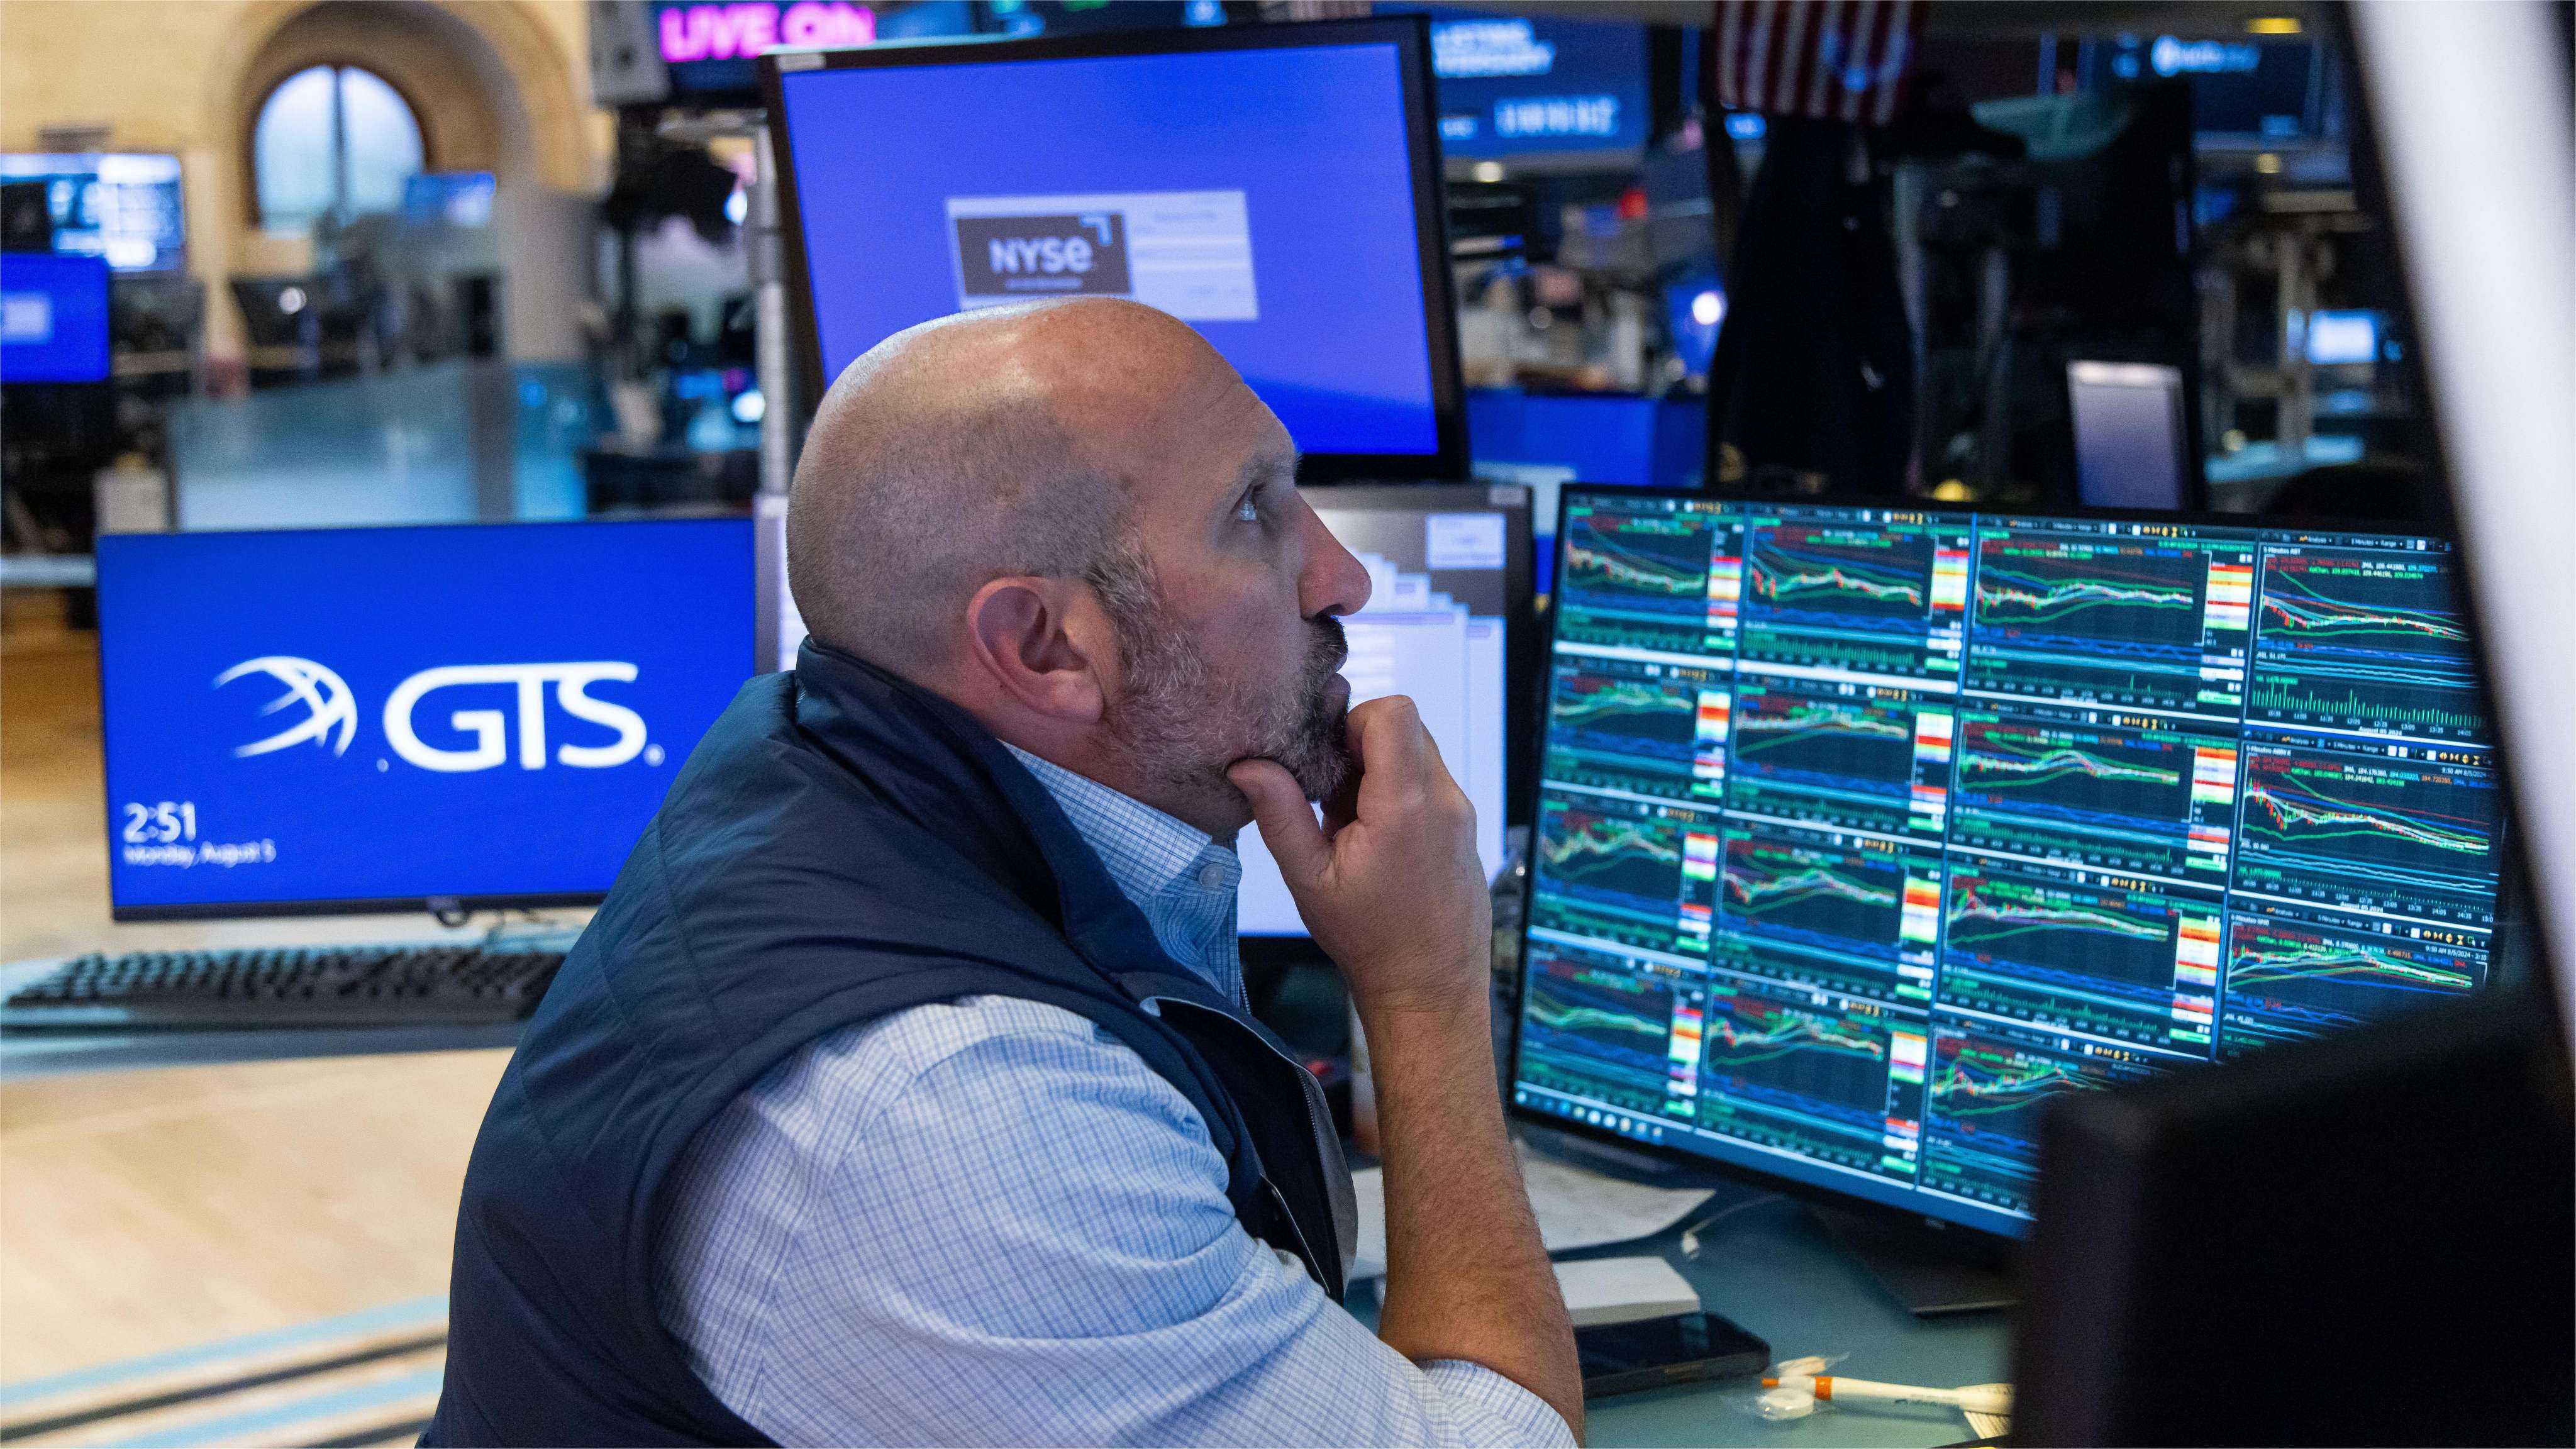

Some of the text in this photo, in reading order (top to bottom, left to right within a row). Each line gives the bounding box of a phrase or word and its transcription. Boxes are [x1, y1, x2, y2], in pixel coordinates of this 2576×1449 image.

[660, 3, 779, 62] LIVE
[383, 661, 647, 772] GTS
[123, 801, 196, 843] 2:51
